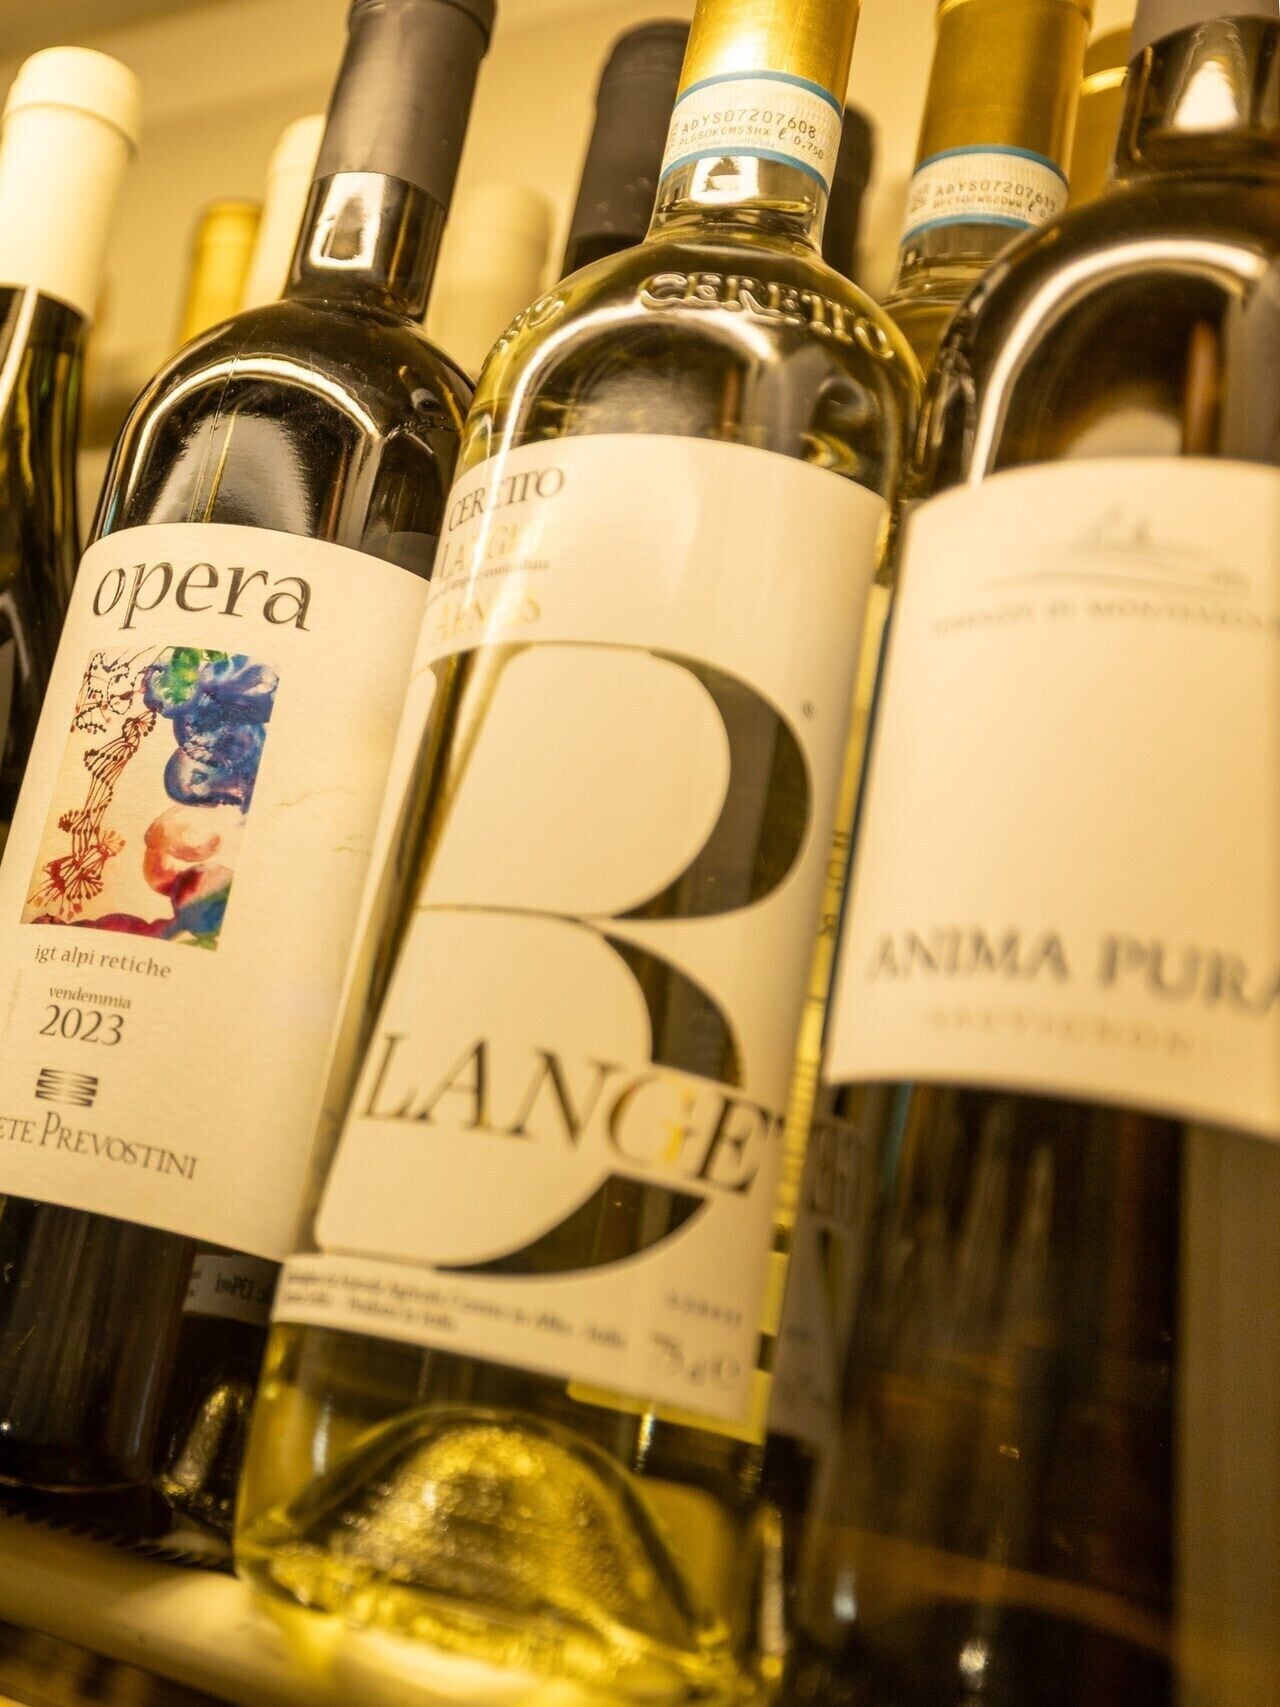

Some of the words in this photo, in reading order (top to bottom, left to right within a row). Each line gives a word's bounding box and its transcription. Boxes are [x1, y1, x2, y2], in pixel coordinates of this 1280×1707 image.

[92, 558, 312, 632] opera
[35, 944, 58, 964] igt
[61, 945, 94, 968] alpi
[100, 953, 171, 979] retiche
[869, 923, 1070, 985] ANIMA
[49, 984, 131, 1010] vendemmia
[39, 1004, 125, 1046] 2023
[39, 1111, 198, 1180] PREVOSTINI
